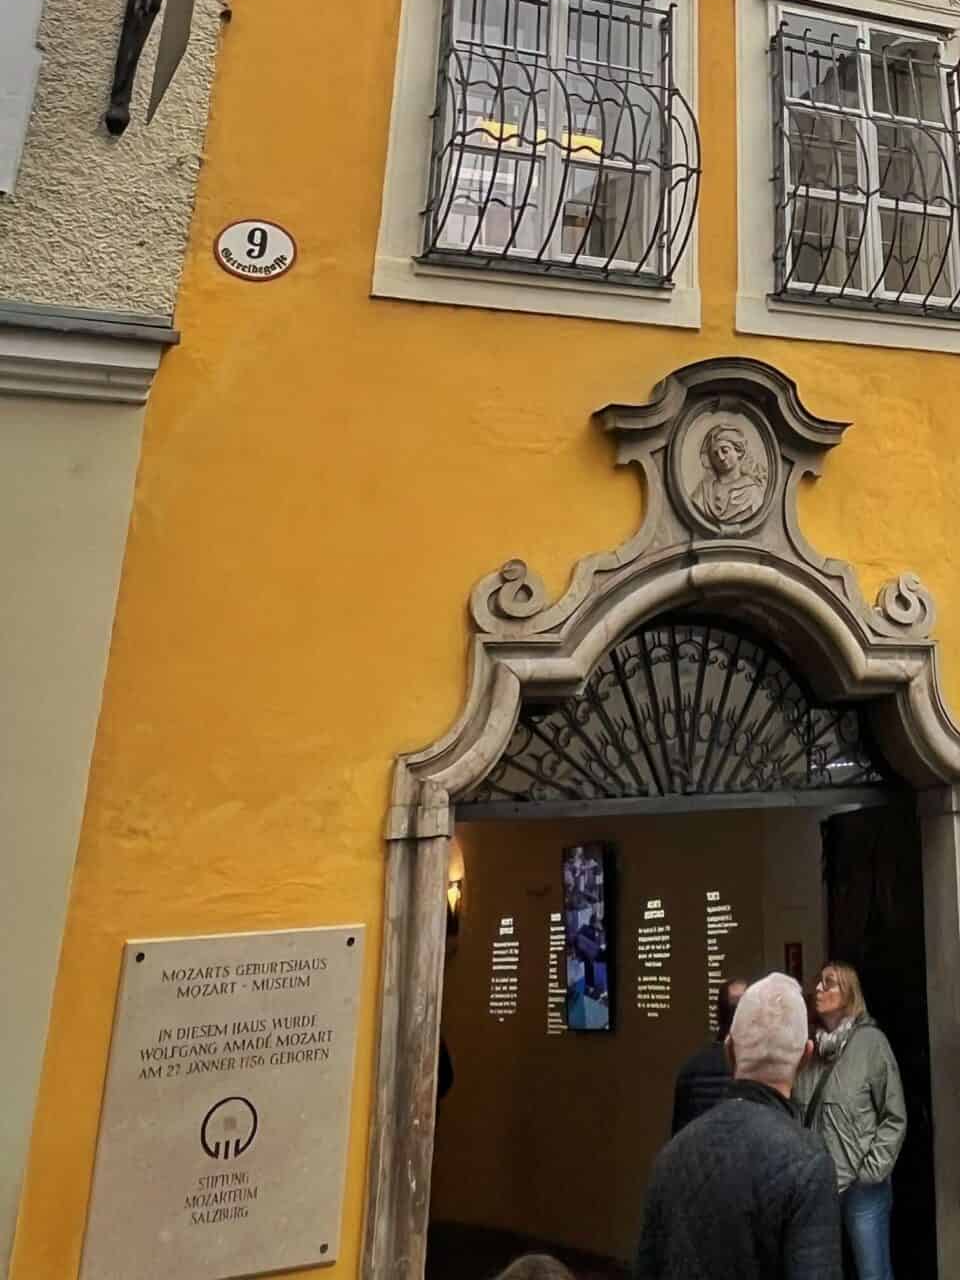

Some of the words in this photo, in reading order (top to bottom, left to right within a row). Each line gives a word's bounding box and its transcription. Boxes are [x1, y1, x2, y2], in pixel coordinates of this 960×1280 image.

[246, 227, 268, 259] 9
[161, 964, 231, 983] MOZARTS
[235, 958, 328, 977] GEBURTSHAUS
[176, 981, 237, 999] MOZART
[252, 975, 311, 992] MUSEUM
[158, 1028, 172, 1043] IN
[176, 1023, 228, 1041] DIESEM
[231, 1019, 267, 1035] HAUS
[272, 1014, 317, 1030] WURDE
[140, 1042, 217, 1062] WOLFGANG
[223, 1032, 272, 1054] AMADÉ
[275, 1030, 334, 1048] MOZART
[138, 1065, 162, 1081] AM
[240, 1055, 265, 1070] 1756
[270, 1047, 330, 1066] GEBOREN
[198, 1172, 249, 1190] STIFTUNG
[184, 1186, 258, 1209] MOZARTEUM
[191, 1207, 249, 1224] SALZBURG
